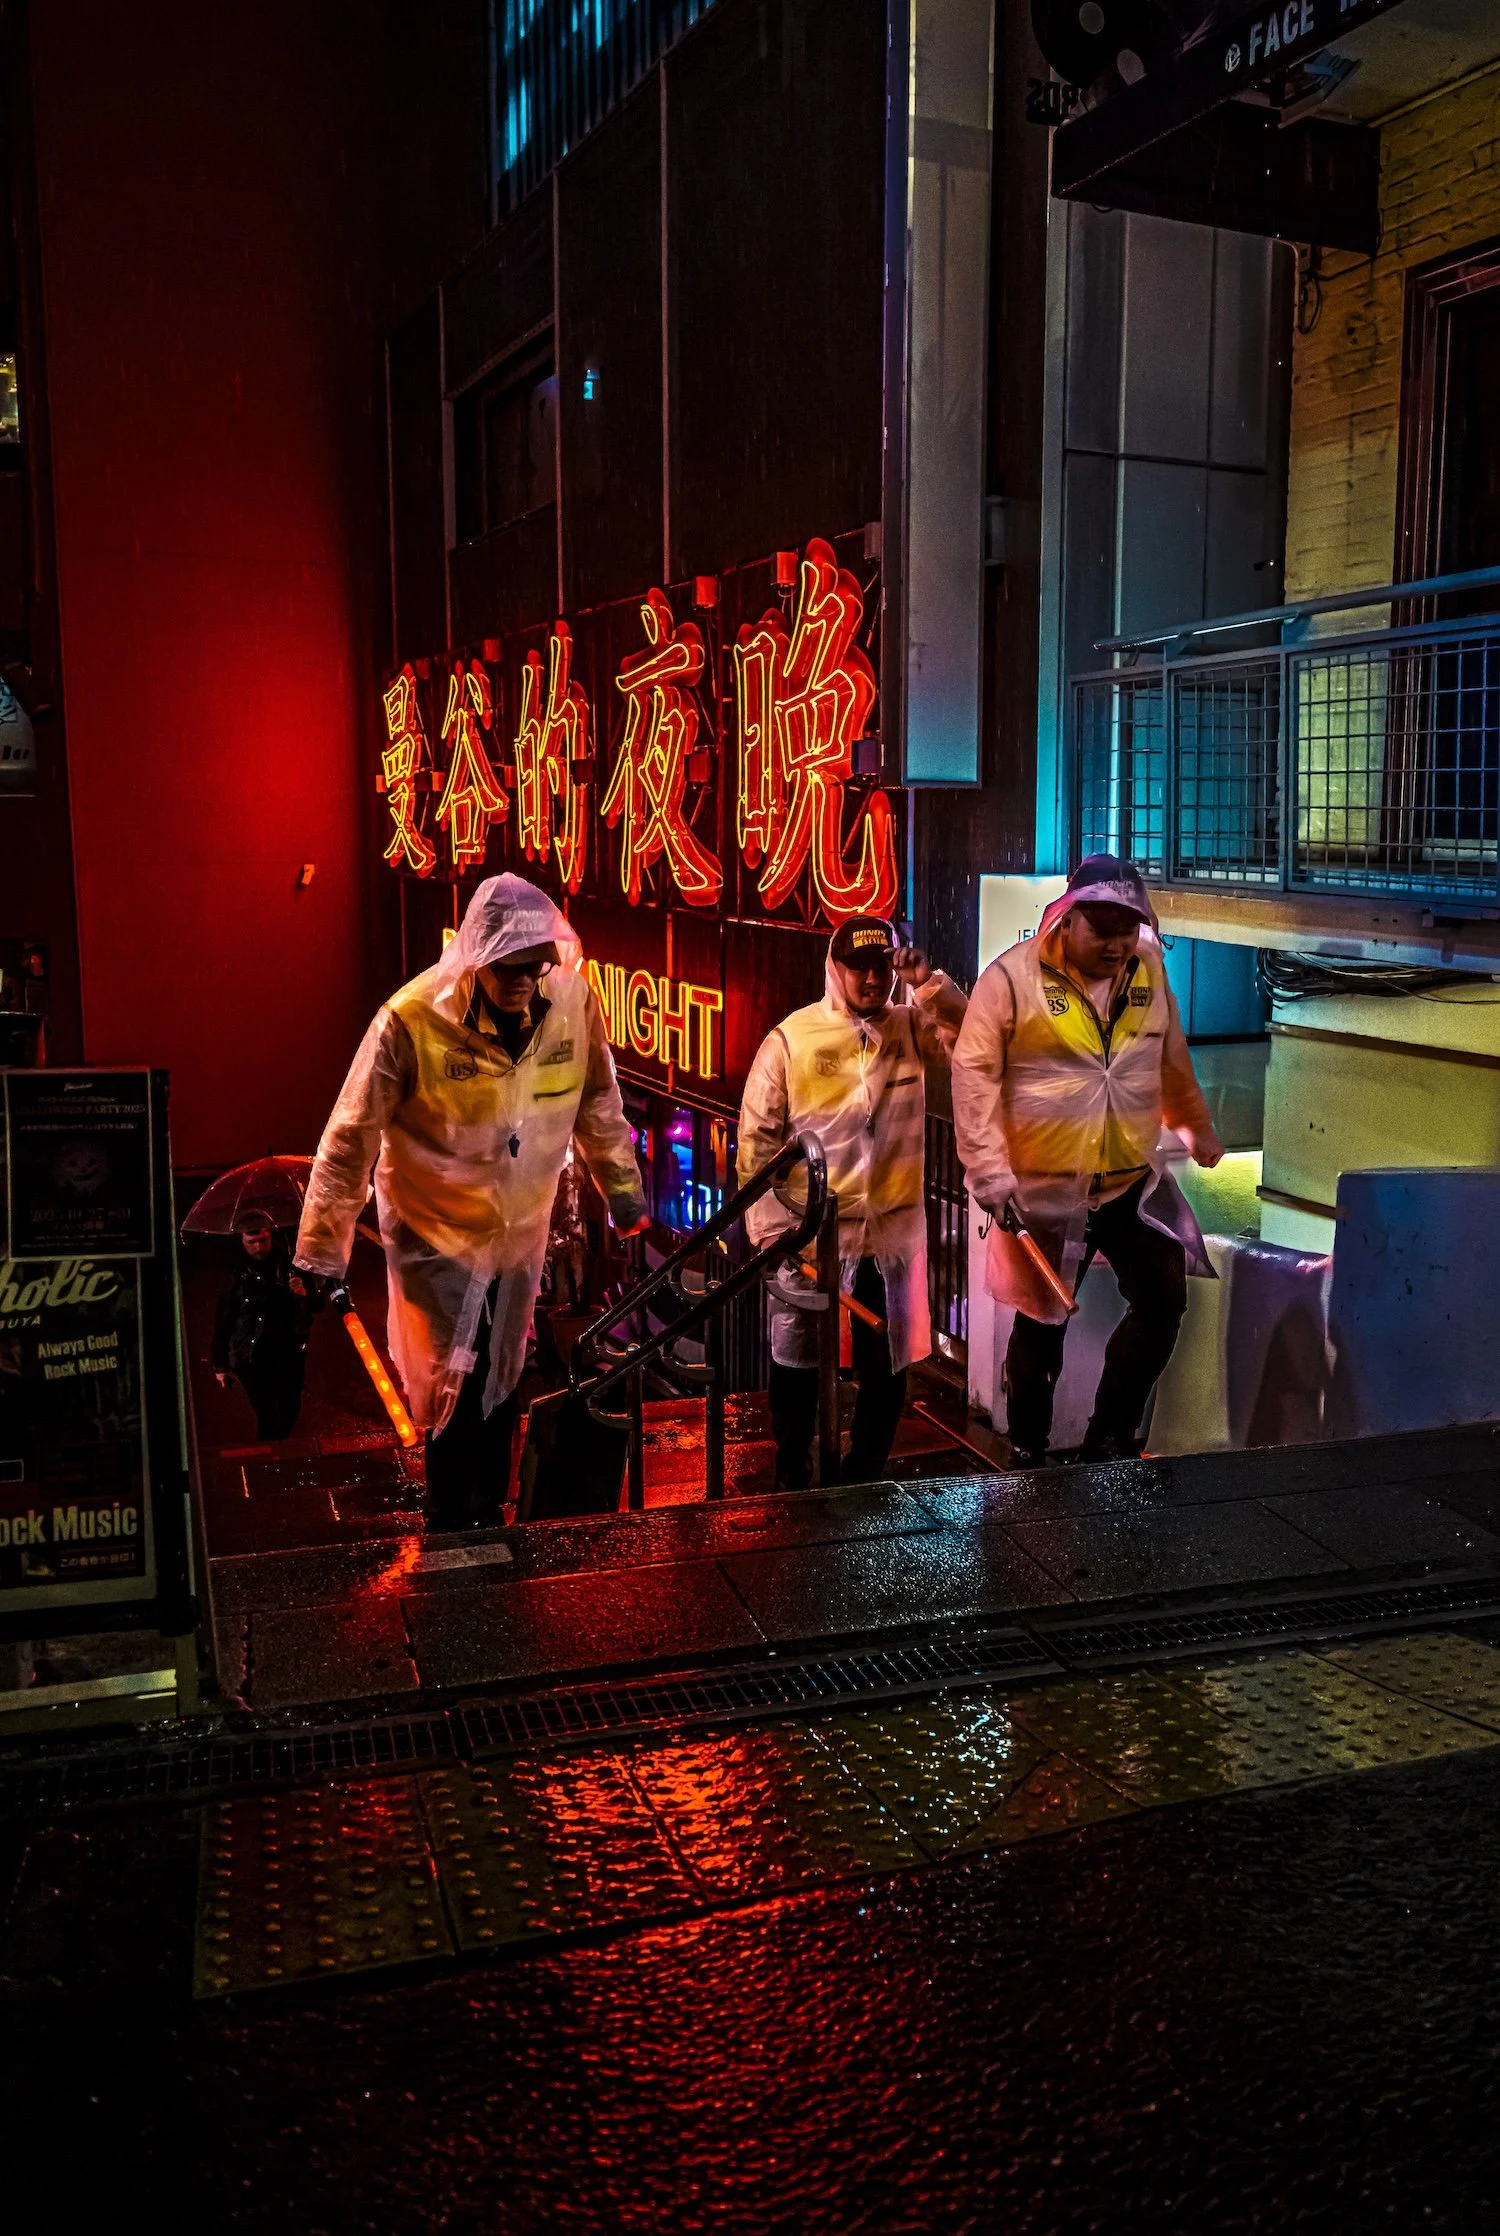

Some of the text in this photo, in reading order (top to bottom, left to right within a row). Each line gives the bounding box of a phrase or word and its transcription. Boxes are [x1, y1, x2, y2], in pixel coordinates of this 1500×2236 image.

[1248, 0, 1315, 66] FACE
[381, 538, 898, 926] 曼谷的夜晚
[587, 959, 723, 1080] NIGHT
[37, 1329, 120, 1360] Always Good
[43, 1353, 119, 1381] Rock Music
[52, 1501, 139, 1543] Music
